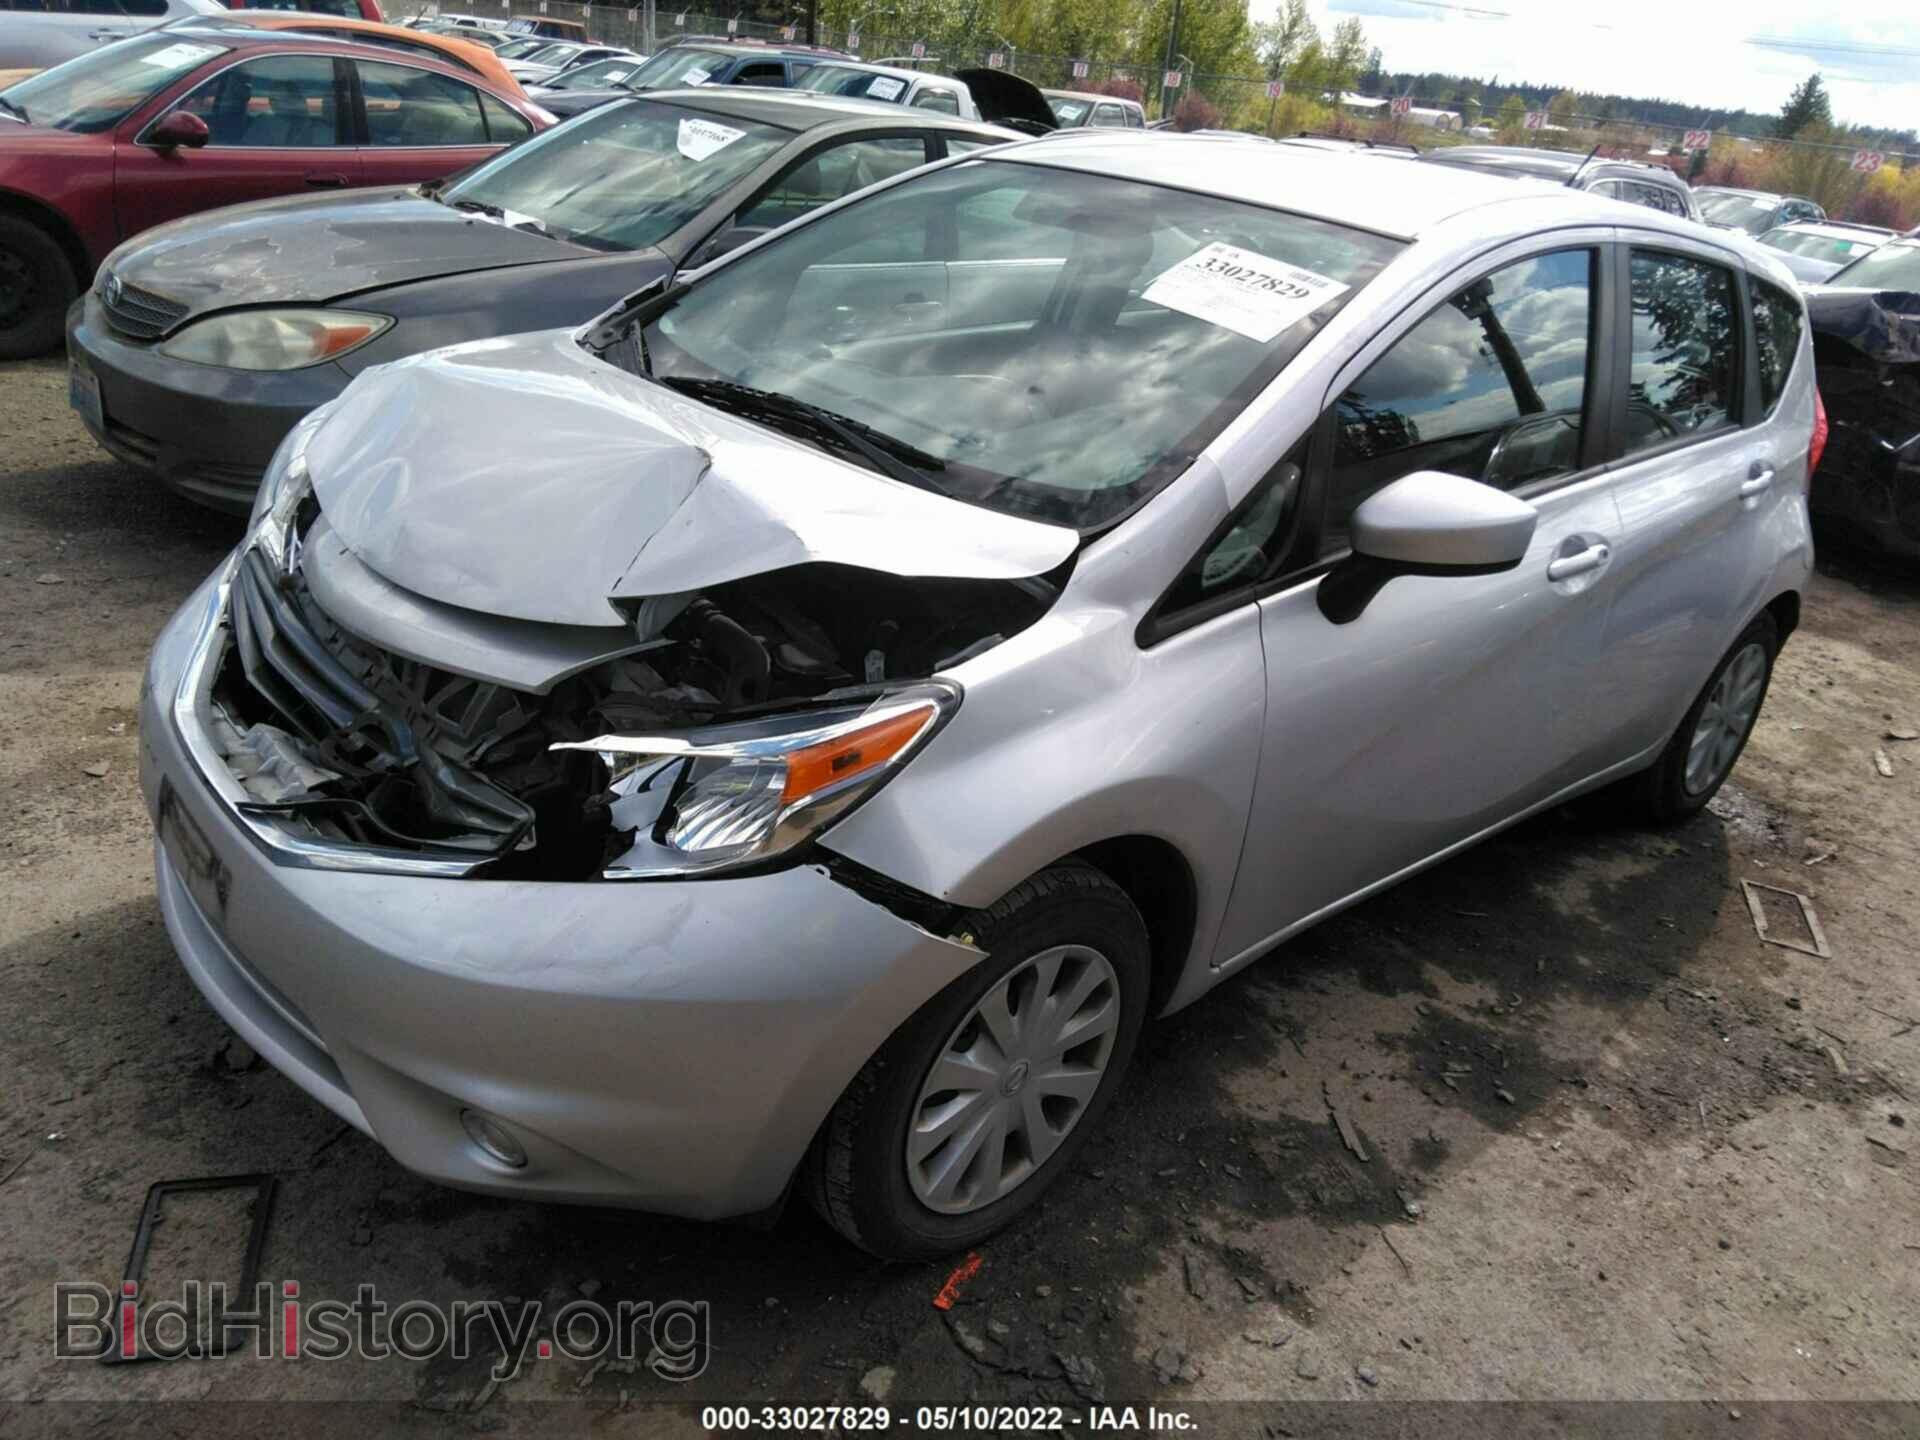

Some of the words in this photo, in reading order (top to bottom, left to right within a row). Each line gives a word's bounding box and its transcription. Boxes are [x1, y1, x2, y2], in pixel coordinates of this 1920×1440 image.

[1392, 98, 1409, 113] 20
[1527, 112, 1544, 128] 21
[1684, 131, 1708, 149] 22
[1855, 151, 1881, 172] 23
[1196, 258, 1310, 299] 33027829
